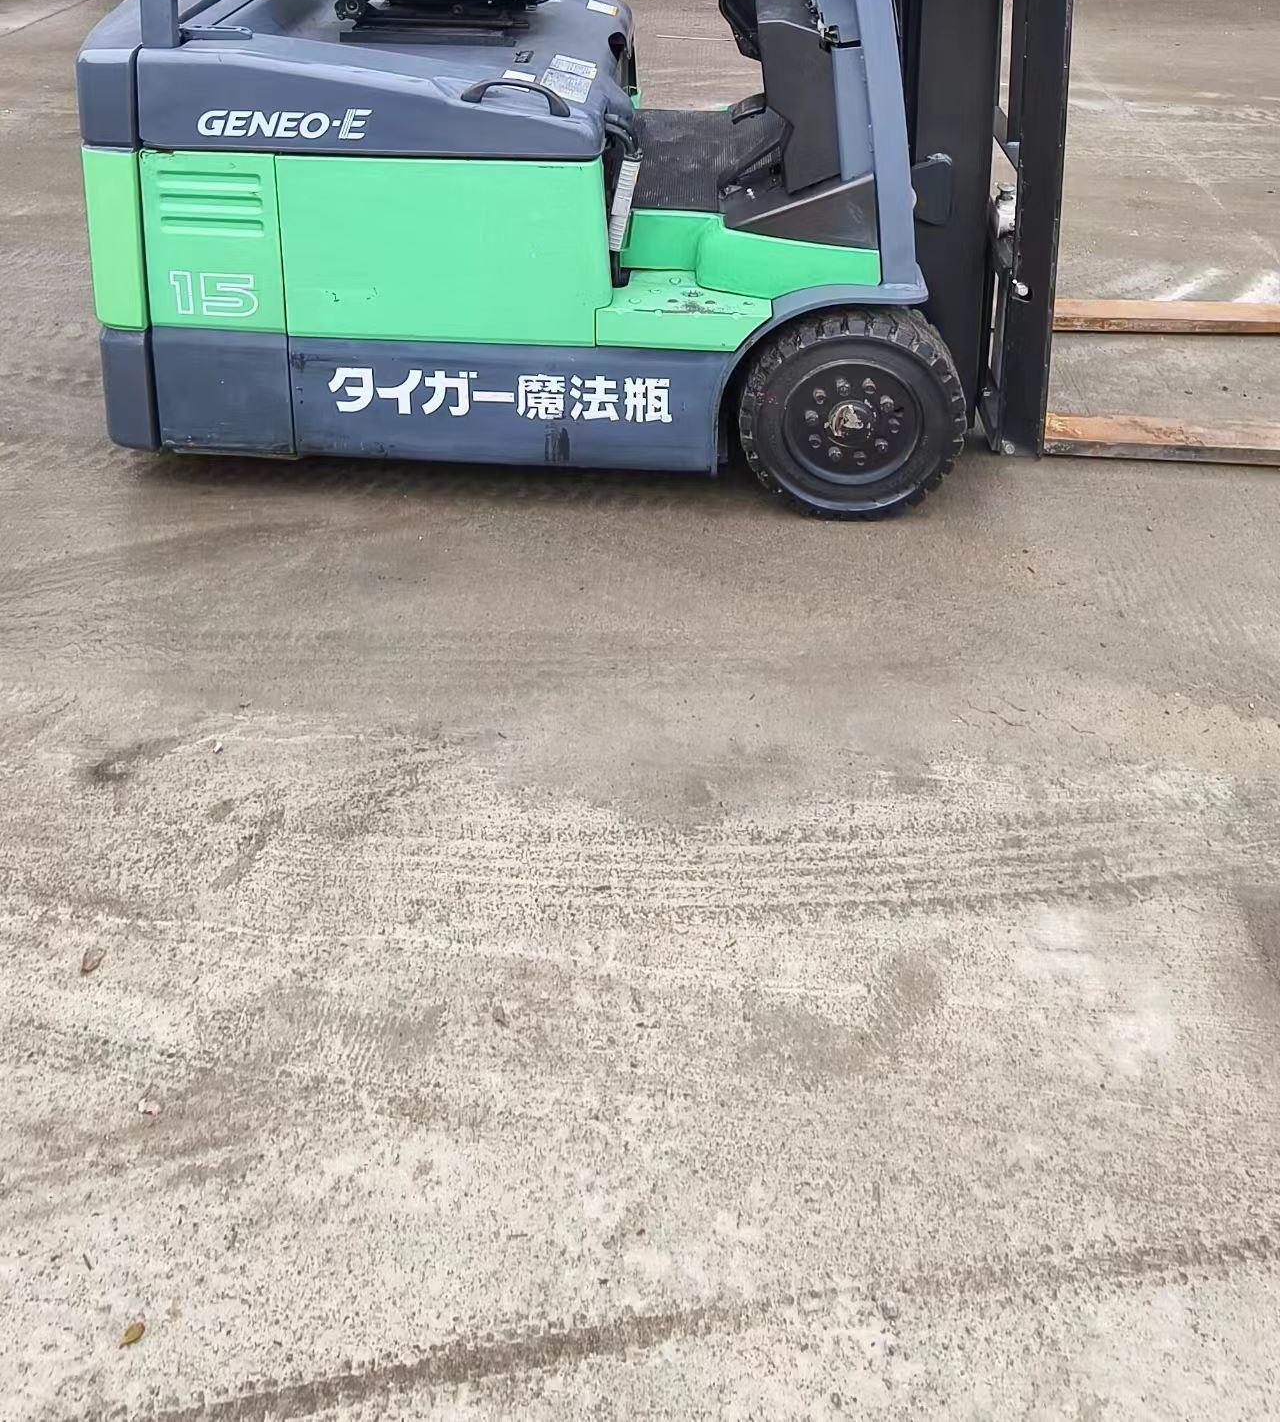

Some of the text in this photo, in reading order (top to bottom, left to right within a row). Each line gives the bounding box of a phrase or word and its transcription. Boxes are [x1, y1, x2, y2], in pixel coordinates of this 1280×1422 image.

[169, 270, 259, 317] 15
[327, 367, 674, 424] タイガー魔法瓶
